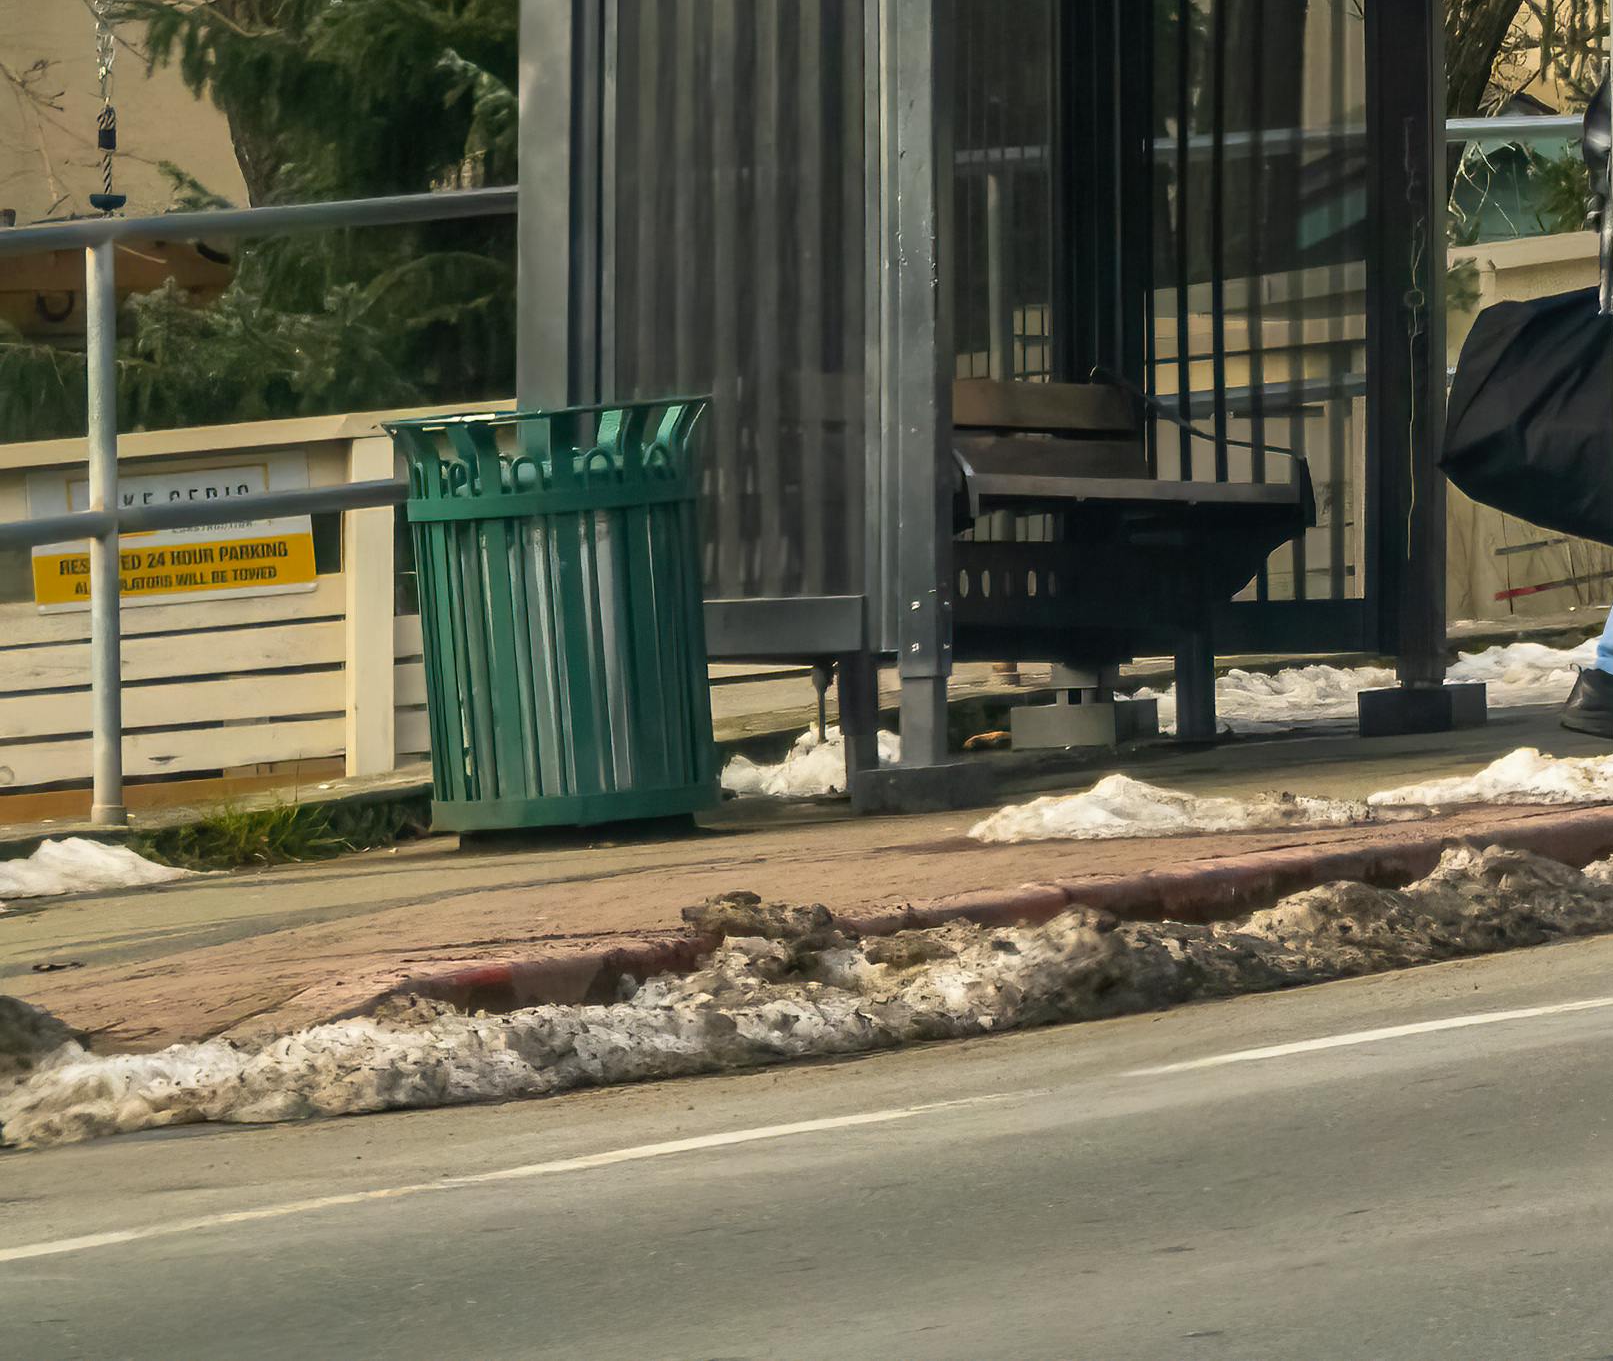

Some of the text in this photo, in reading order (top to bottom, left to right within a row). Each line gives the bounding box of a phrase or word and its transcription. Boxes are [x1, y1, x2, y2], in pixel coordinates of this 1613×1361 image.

[147, 550, 166, 569] 24
[171, 546, 215, 565] HOUR
[219, 540, 289, 562] PARKING
[176, 570, 204, 587] WILL
[211, 569, 228, 584] BE
[233, 565, 277, 581] TOWED
